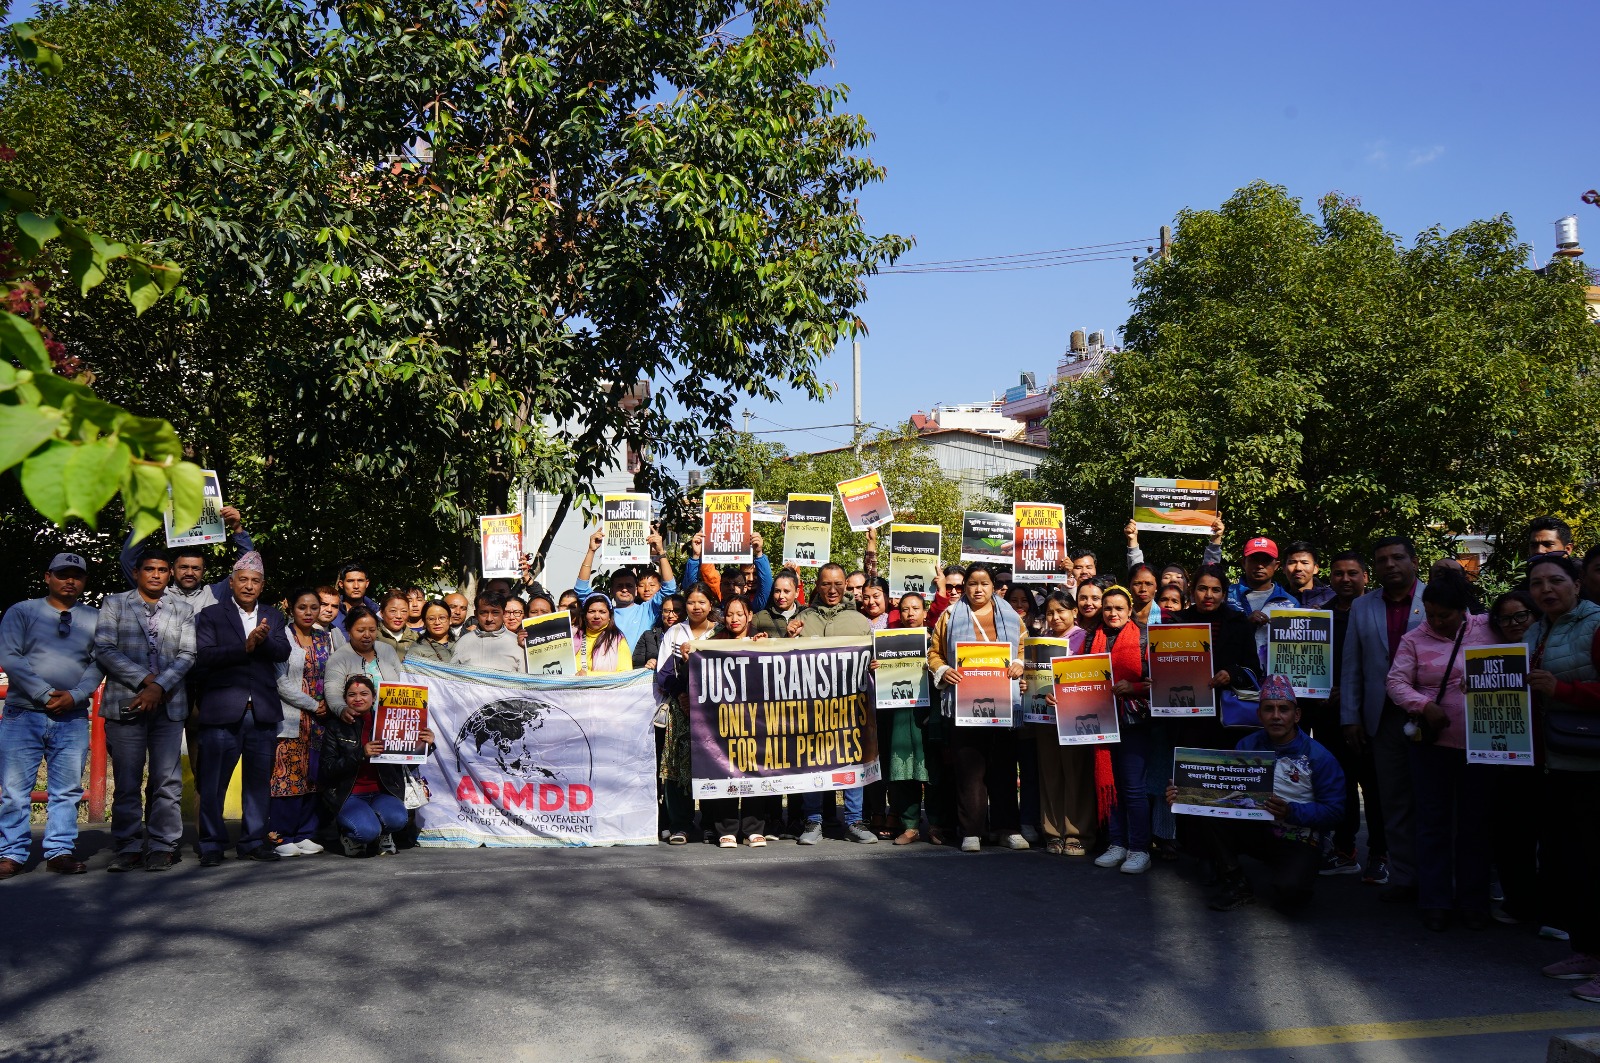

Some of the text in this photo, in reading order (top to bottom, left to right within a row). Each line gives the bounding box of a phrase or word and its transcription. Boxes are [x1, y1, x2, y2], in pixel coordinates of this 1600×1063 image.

[618, 501, 635, 510] JUST
[607, 510, 647, 519] TRANSITION
[712, 513, 743, 523] PEOPLES
[1022, 509, 1031, 517] WE
[1047, 510, 1057, 518] THE
[712, 522, 744, 532] PROTECT
[1026, 518, 1053, 526] ANSWER:
[710, 532, 745, 543] LIFE, NOT
[1024, 529, 1057, 540] PEOPLES
[714, 542, 741, 552] PROFIT!
[1023, 540, 1057, 550] PROTECT
[65, 555, 79, 564] 43
[1022, 550, 1059, 561] LIFE, NOT
[1025, 560, 1056, 570] PROFIT!
[1289, 619, 1311, 630] JUST
[1274, 629, 1326, 641] TRANSITION
[1277, 644, 1323, 654] ONLY WITH
[1277, 654, 1324, 665] RIGHTS FOR
[1274, 664, 1326, 675] ALL PEOPLES
[1483, 659, 1504, 674] JUST
[698, 650, 871, 704] JUST TRANSITIO
[1469, 673, 1522, 688] TRANSITION
[386, 688, 422, 698] WE ARE THE
[390, 697, 418, 706] ANSWER:
[1474, 693, 1519, 707] ONLY WITH
[386, 708, 420, 720] PEOPLES
[718, 692, 867, 738] ONLY WITH RIGHTS
[1474, 707, 1522, 721] RIGHTS FOR
[384, 719, 420, 730] PROTECT
[1472, 720, 1525, 734] ALL PEOPLES
[382, 729, 420, 742] LIFE, NOT
[384, 740, 416, 751] PROFIT!
[729, 728, 863, 772] FOR ALL PEOPLES
[1180, 763, 1215, 772] आयातमा
[456, 775, 594, 812] APMDD
[458, 814, 593, 833] ON DEBT AND VELOPMENT
[531, 814, 590, 824] MOVEMENT
